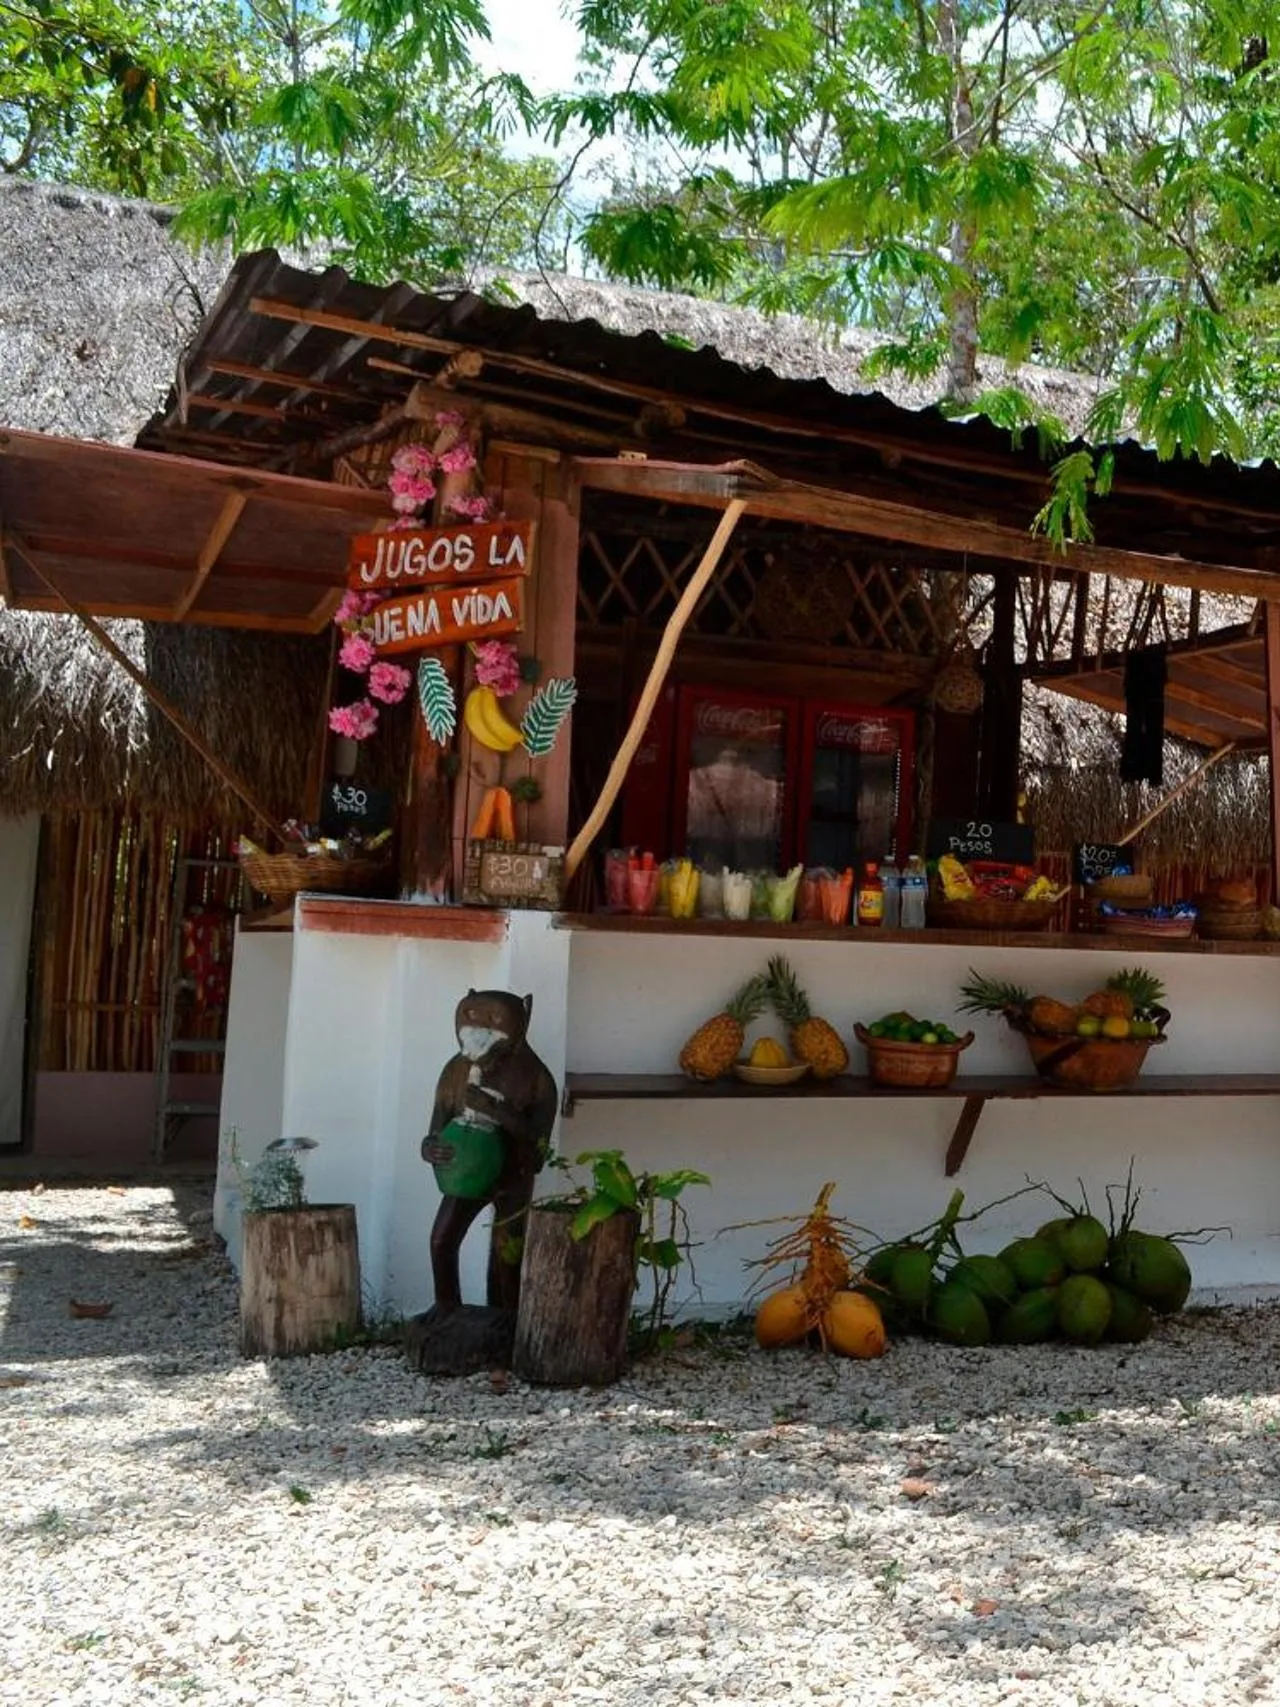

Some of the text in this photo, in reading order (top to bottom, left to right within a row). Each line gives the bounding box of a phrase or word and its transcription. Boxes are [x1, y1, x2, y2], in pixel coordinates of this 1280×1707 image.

[361, 534, 525, 583] JUGOS LA
[363, 597, 442, 646] UENA
[967, 822, 993, 837] 20
[950, 836, 993, 853] Pesos
[488, 856, 528, 876] $30
